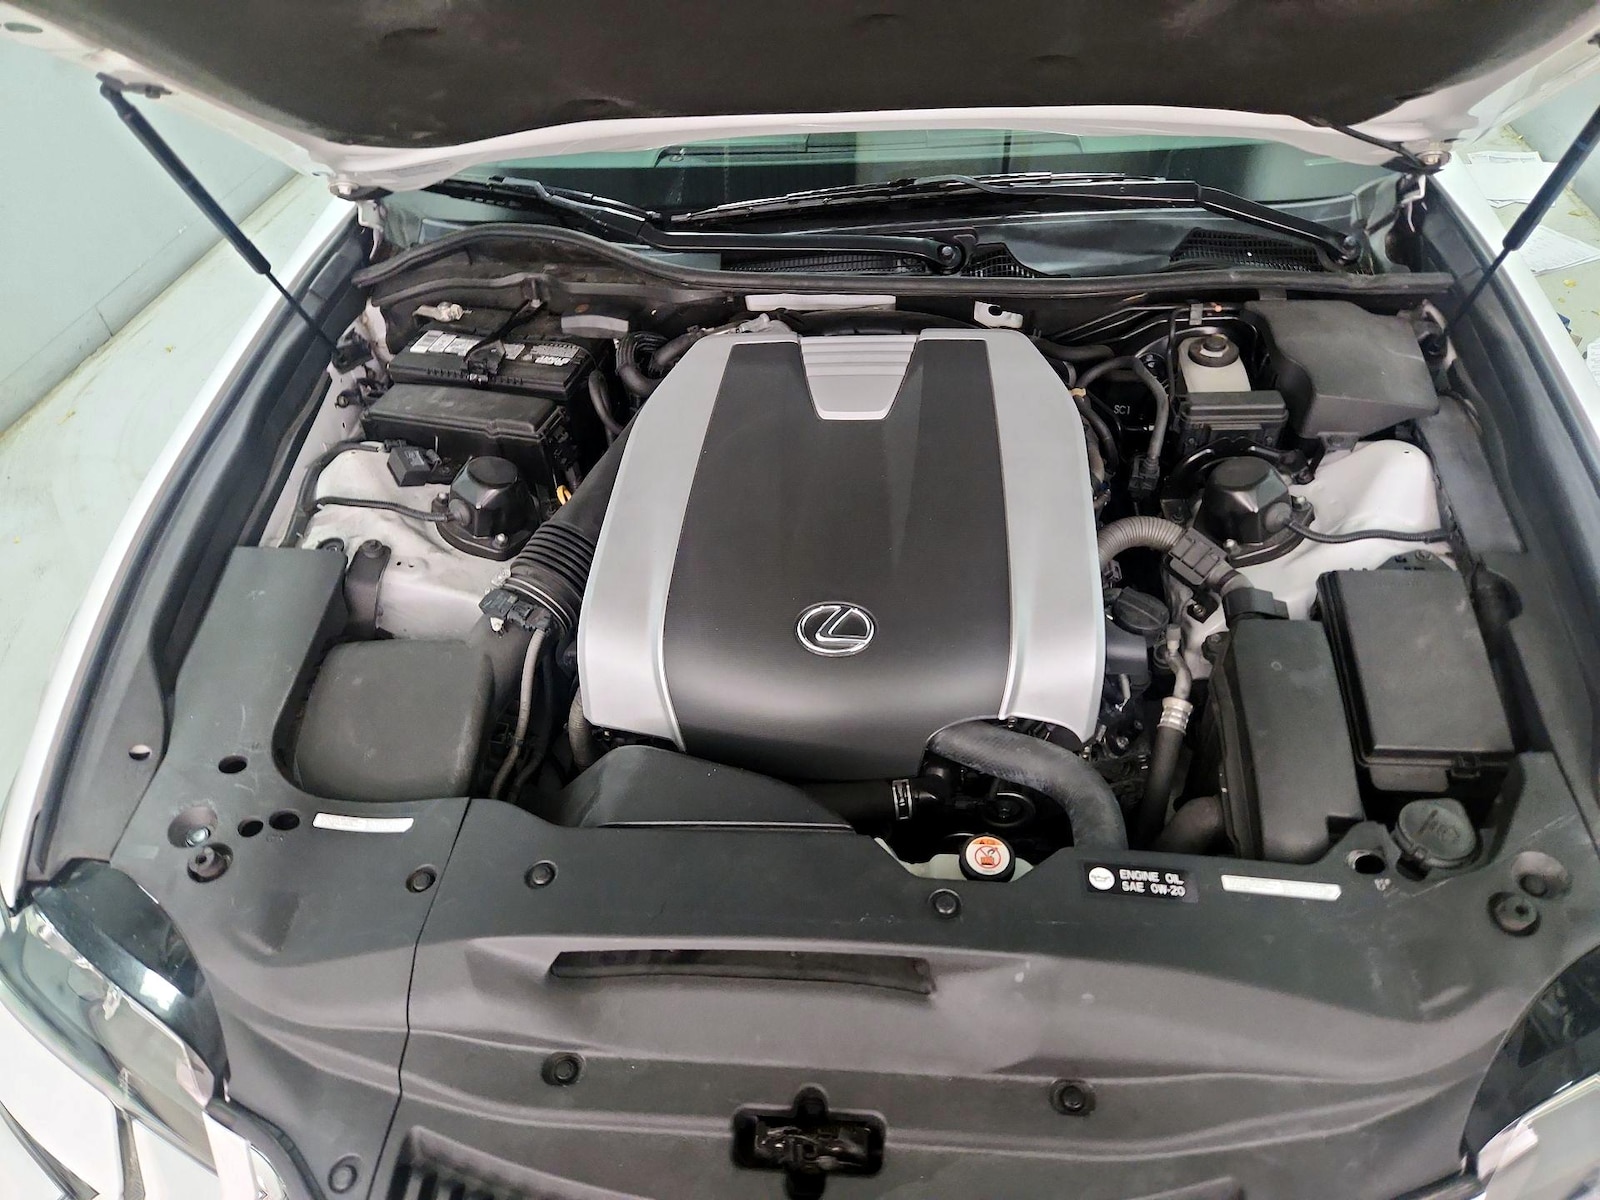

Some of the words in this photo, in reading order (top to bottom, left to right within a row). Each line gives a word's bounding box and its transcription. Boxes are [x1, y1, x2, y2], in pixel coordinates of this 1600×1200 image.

[1119, 869, 1160, 882] ENGINE
[1165, 873, 1184, 885] OIL
[1121, 881, 1145, 893] SAE
[1150, 883, 1186, 896] 0W-20
